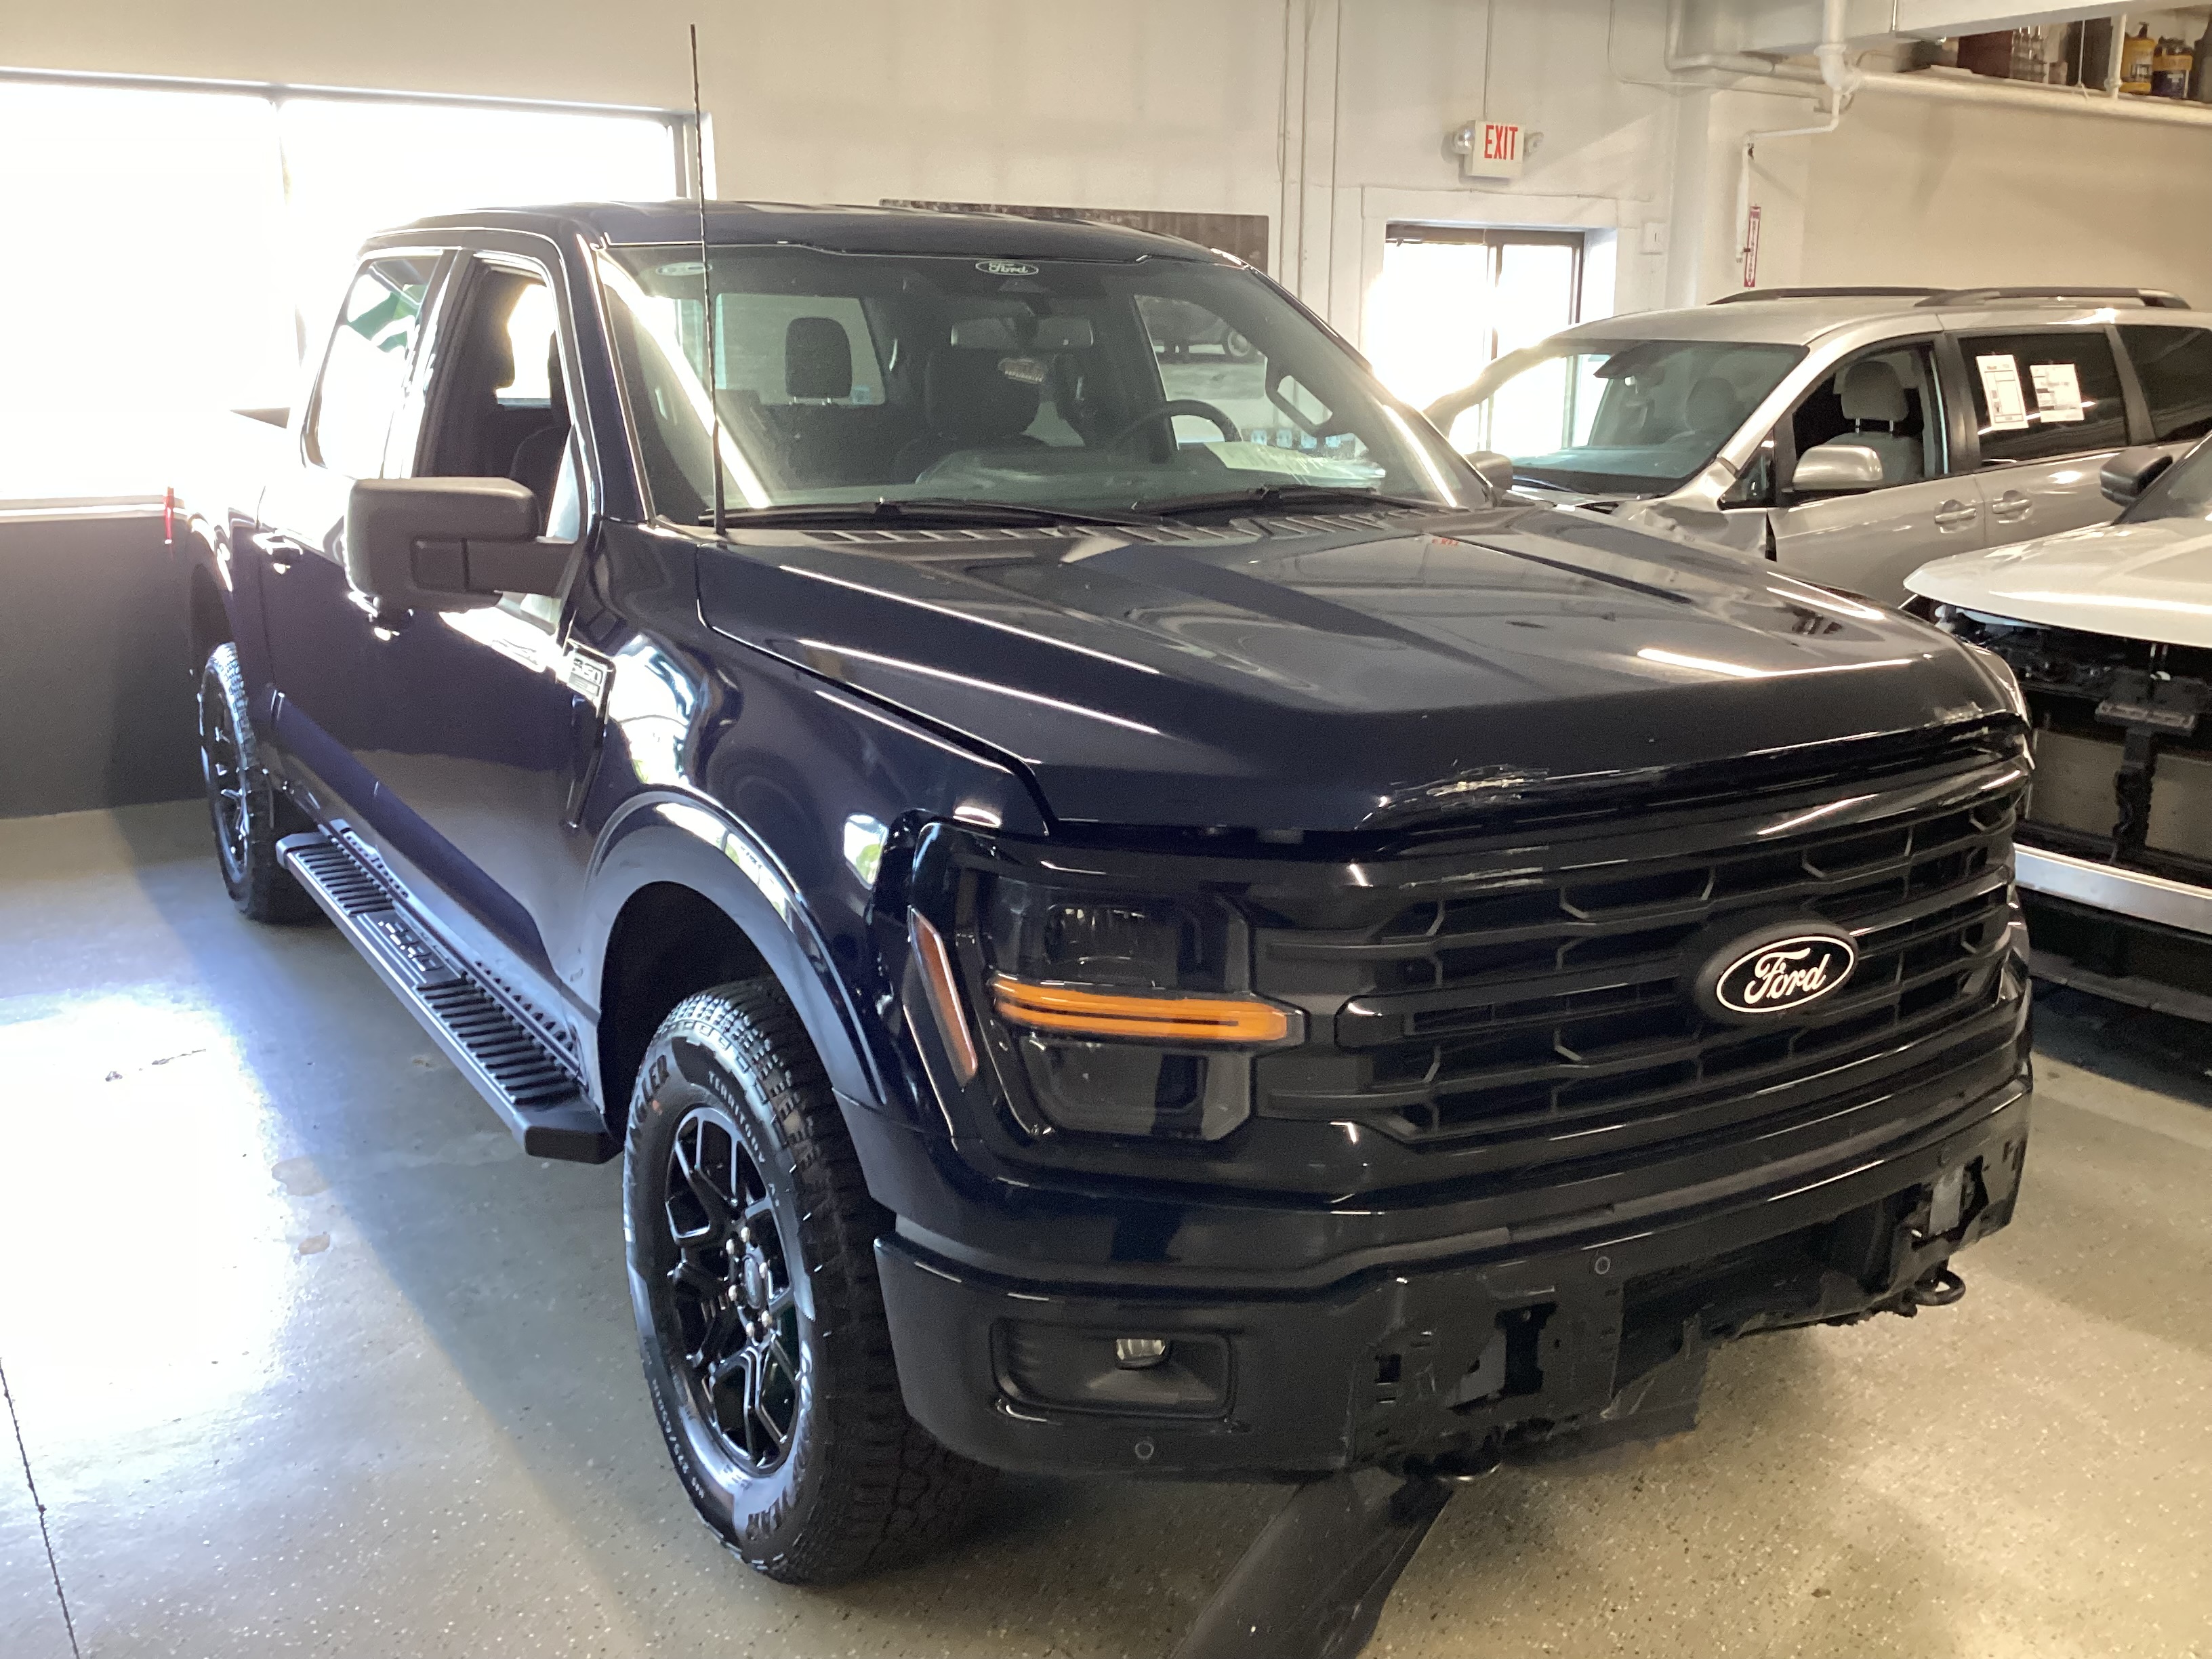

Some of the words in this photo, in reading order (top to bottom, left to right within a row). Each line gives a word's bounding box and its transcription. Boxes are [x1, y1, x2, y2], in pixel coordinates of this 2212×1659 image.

[1484, 124, 1518, 160] EXIT
[988, 261, 1028, 273] Ford
[1744, 947, 1830, 1004] Ford
